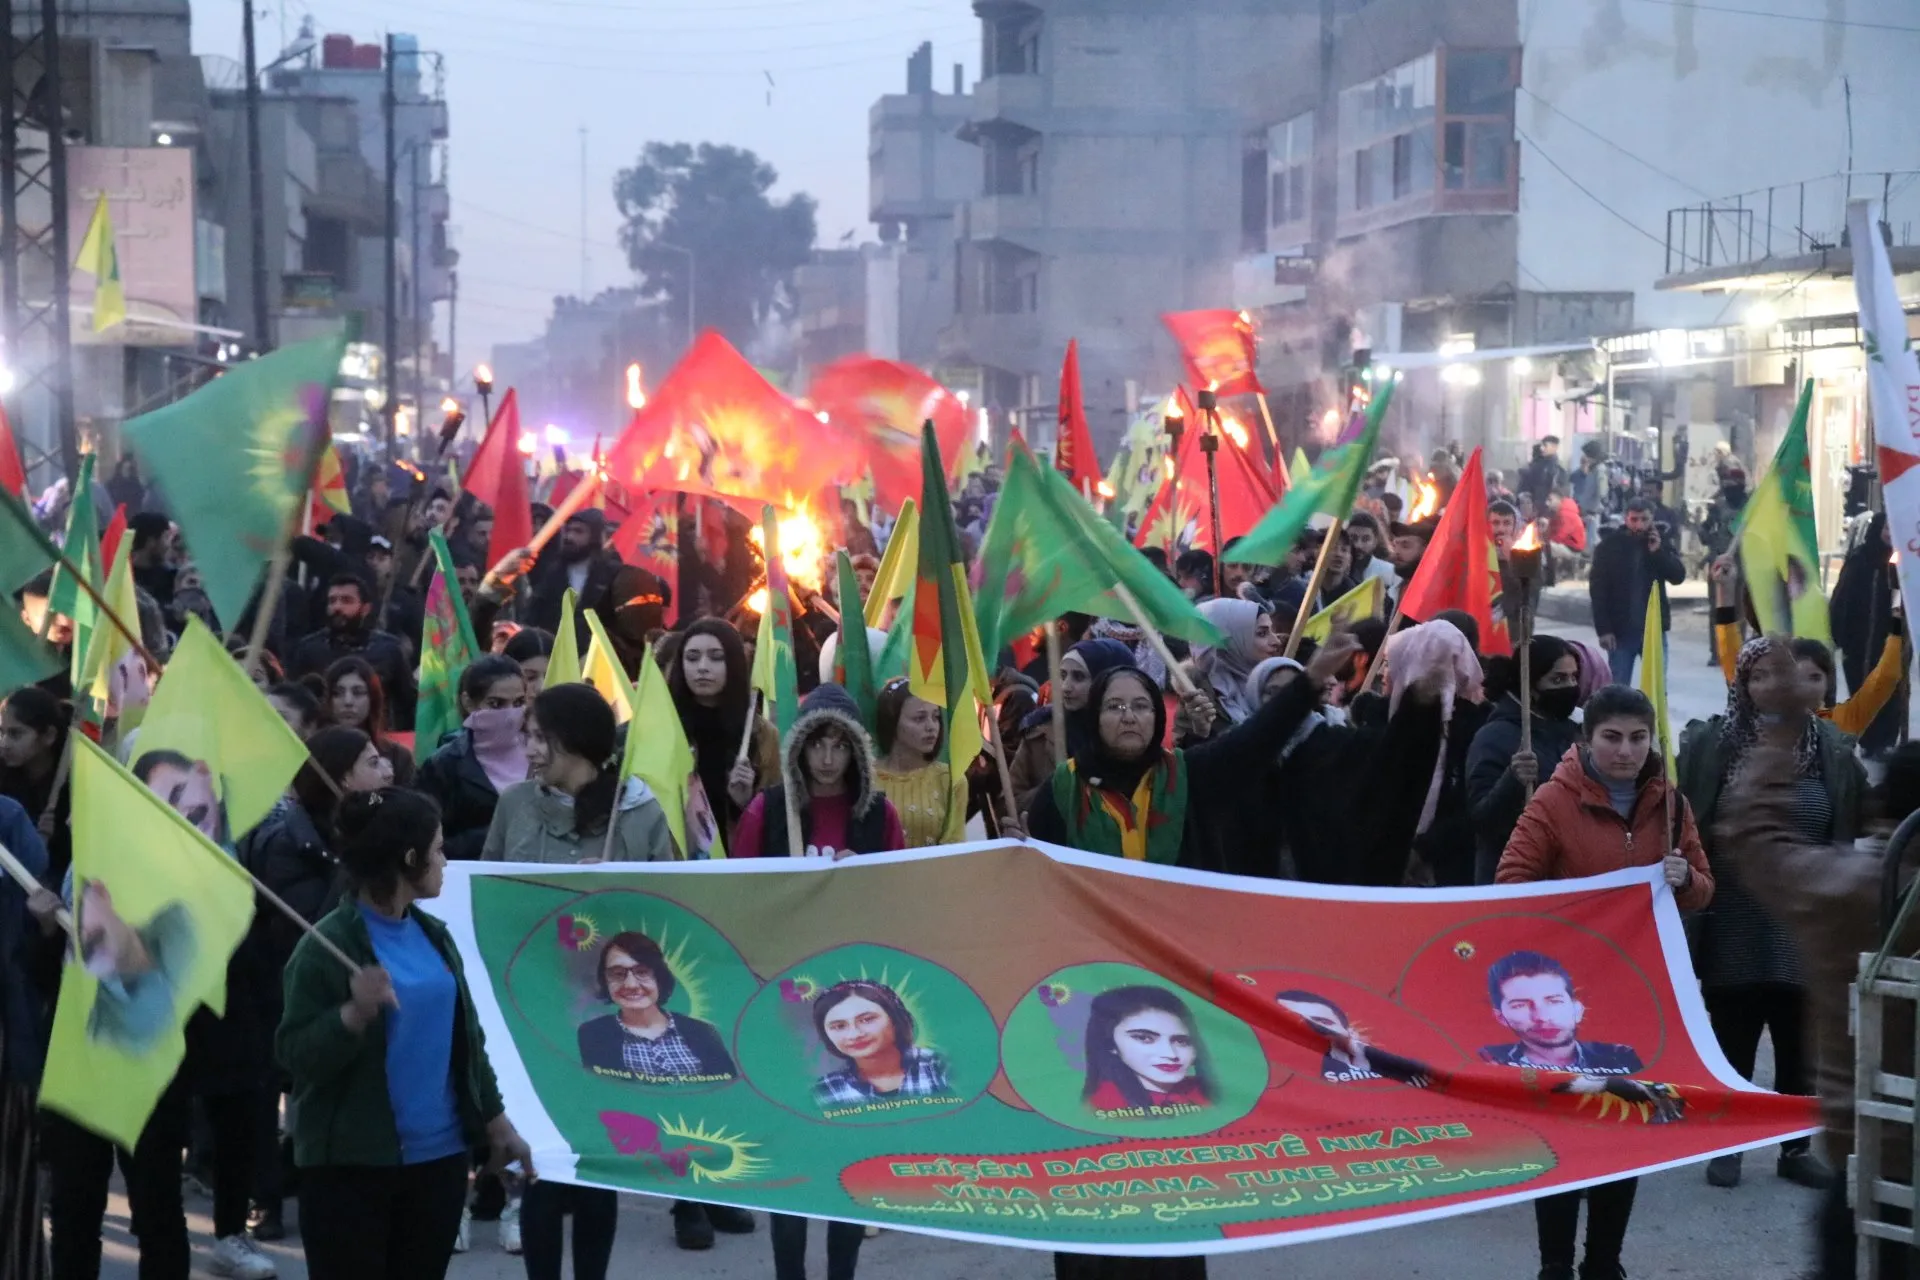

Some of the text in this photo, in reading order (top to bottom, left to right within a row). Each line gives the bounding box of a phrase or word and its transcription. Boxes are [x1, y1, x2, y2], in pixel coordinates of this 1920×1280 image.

[1043, 1134, 1309, 1177] DAGIRKERIYÊ
[1317, 1122, 1473, 1154] NIKARE
[1050, 1174, 1221, 1202] CIWANA
[1225, 1164, 1340, 1189] TUNE
[1346, 1155, 1444, 1178] BIKE
[1271, 1187, 1302, 1207] لن
